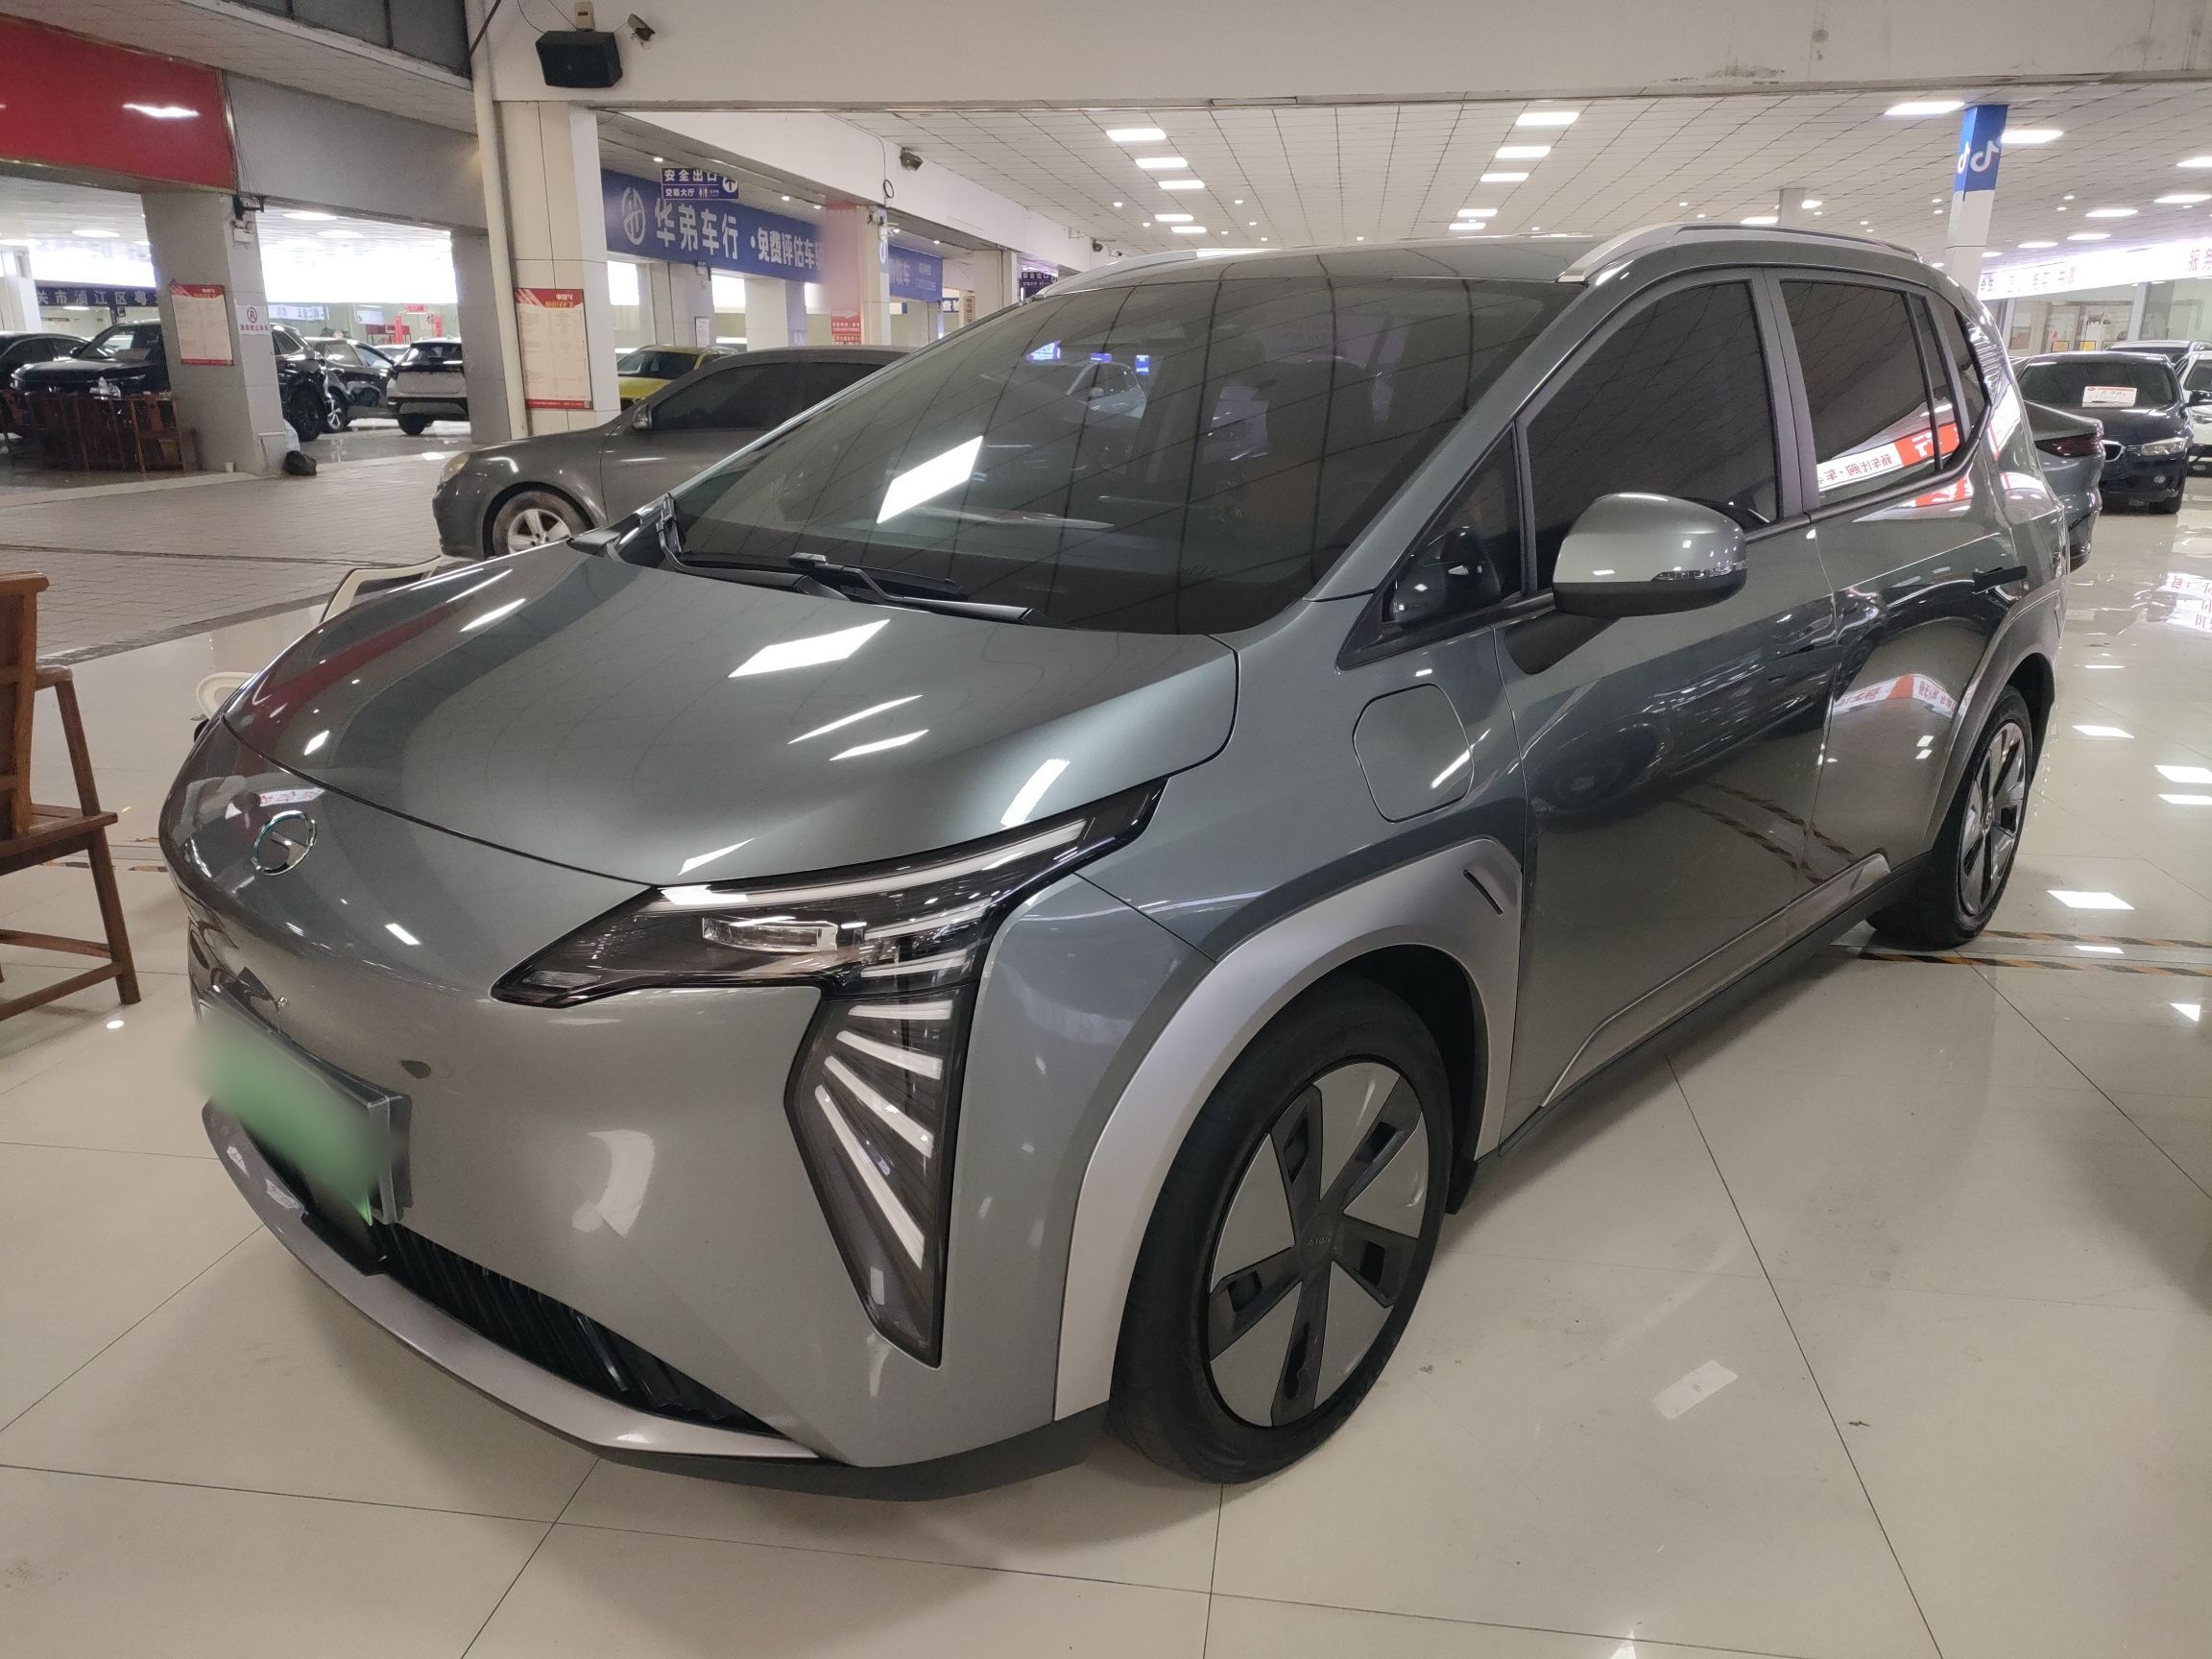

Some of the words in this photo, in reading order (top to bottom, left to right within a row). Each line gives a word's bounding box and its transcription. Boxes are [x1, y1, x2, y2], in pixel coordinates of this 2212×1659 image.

[664, 169, 717, 181] 安全出口
[665, 188, 695, 197] 交易大厅
